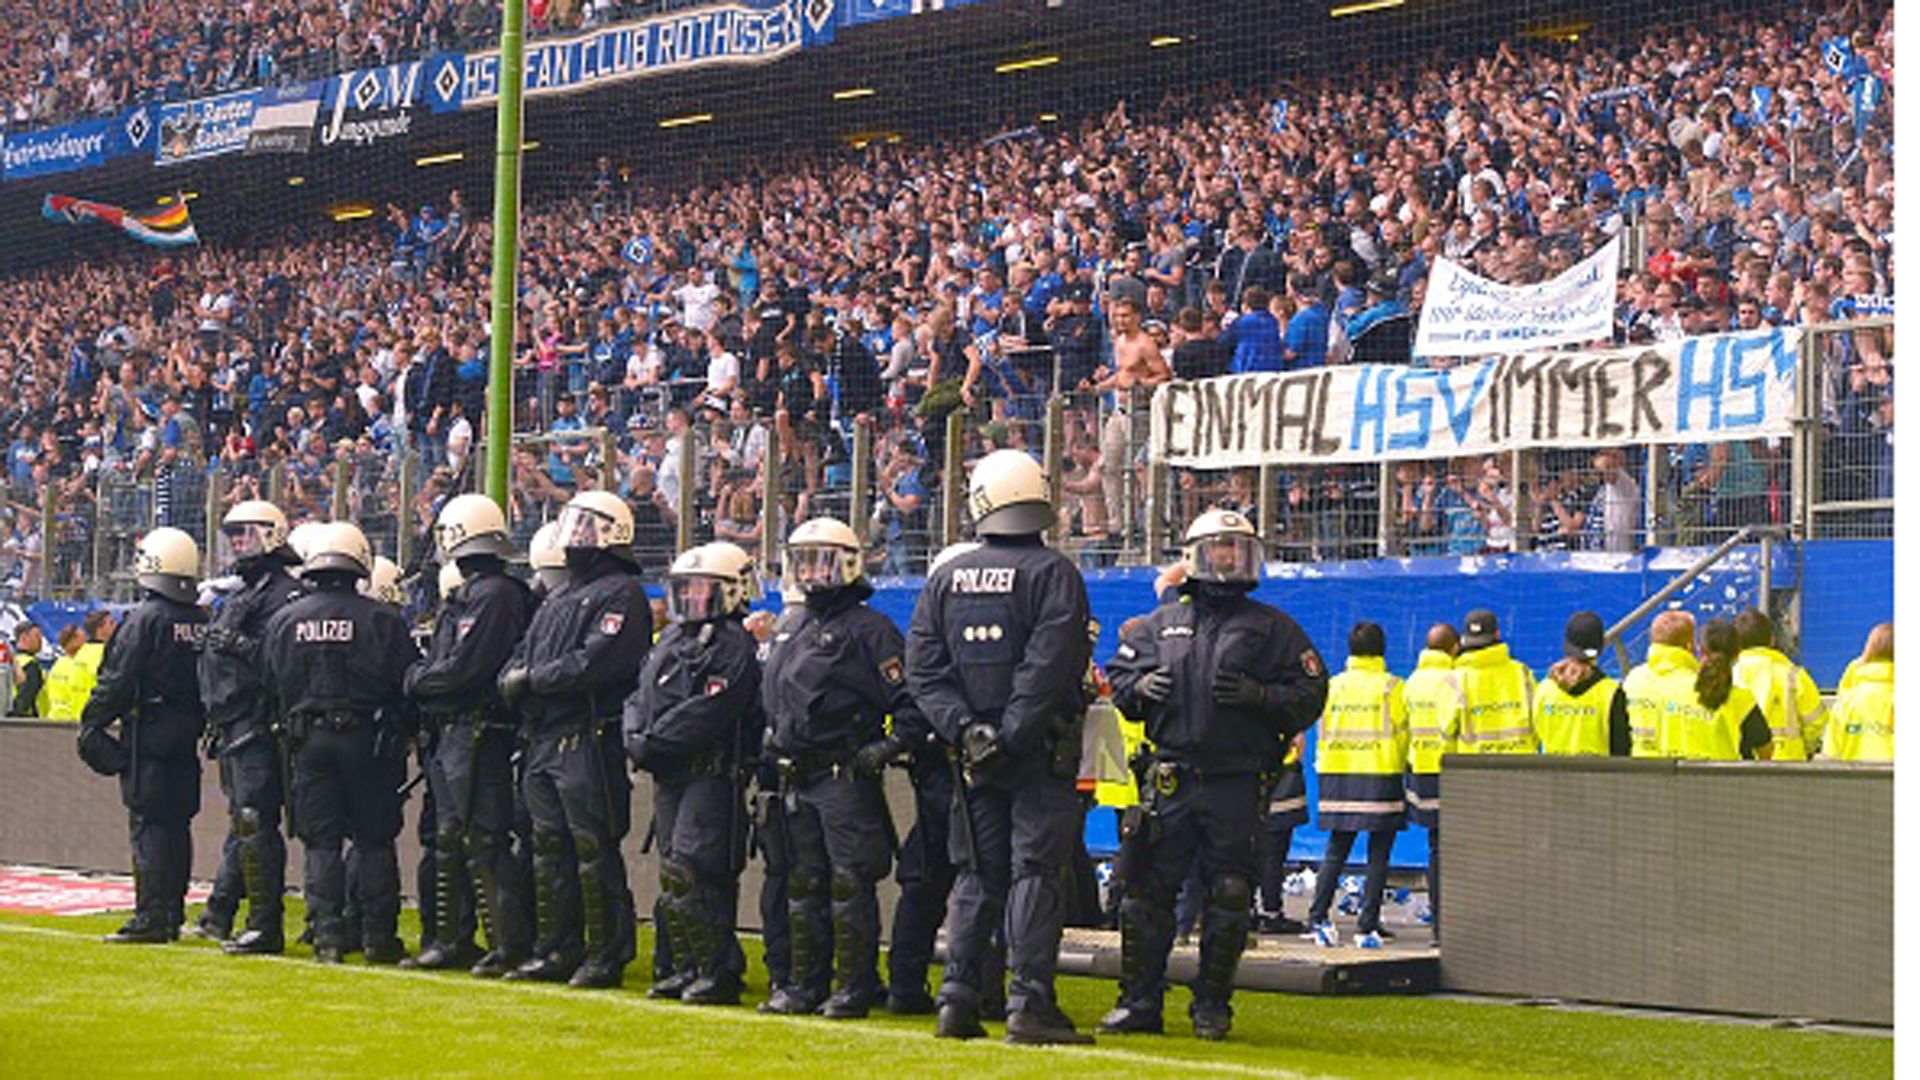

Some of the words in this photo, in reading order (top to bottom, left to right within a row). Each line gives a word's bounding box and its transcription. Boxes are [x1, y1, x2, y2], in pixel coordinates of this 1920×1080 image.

[463, 57, 500, 100] HS
[524, 46, 571, 89] FAN
[580, 33, 647, 79] CLUB
[1165, 371, 1341, 456] EINMAL
[1350, 358, 1496, 454] HSV
[1490, 350, 1671, 443] IMMER
[953, 568, 1015, 592] POLIZEI
[296, 620, 353, 641] POLIZEI
